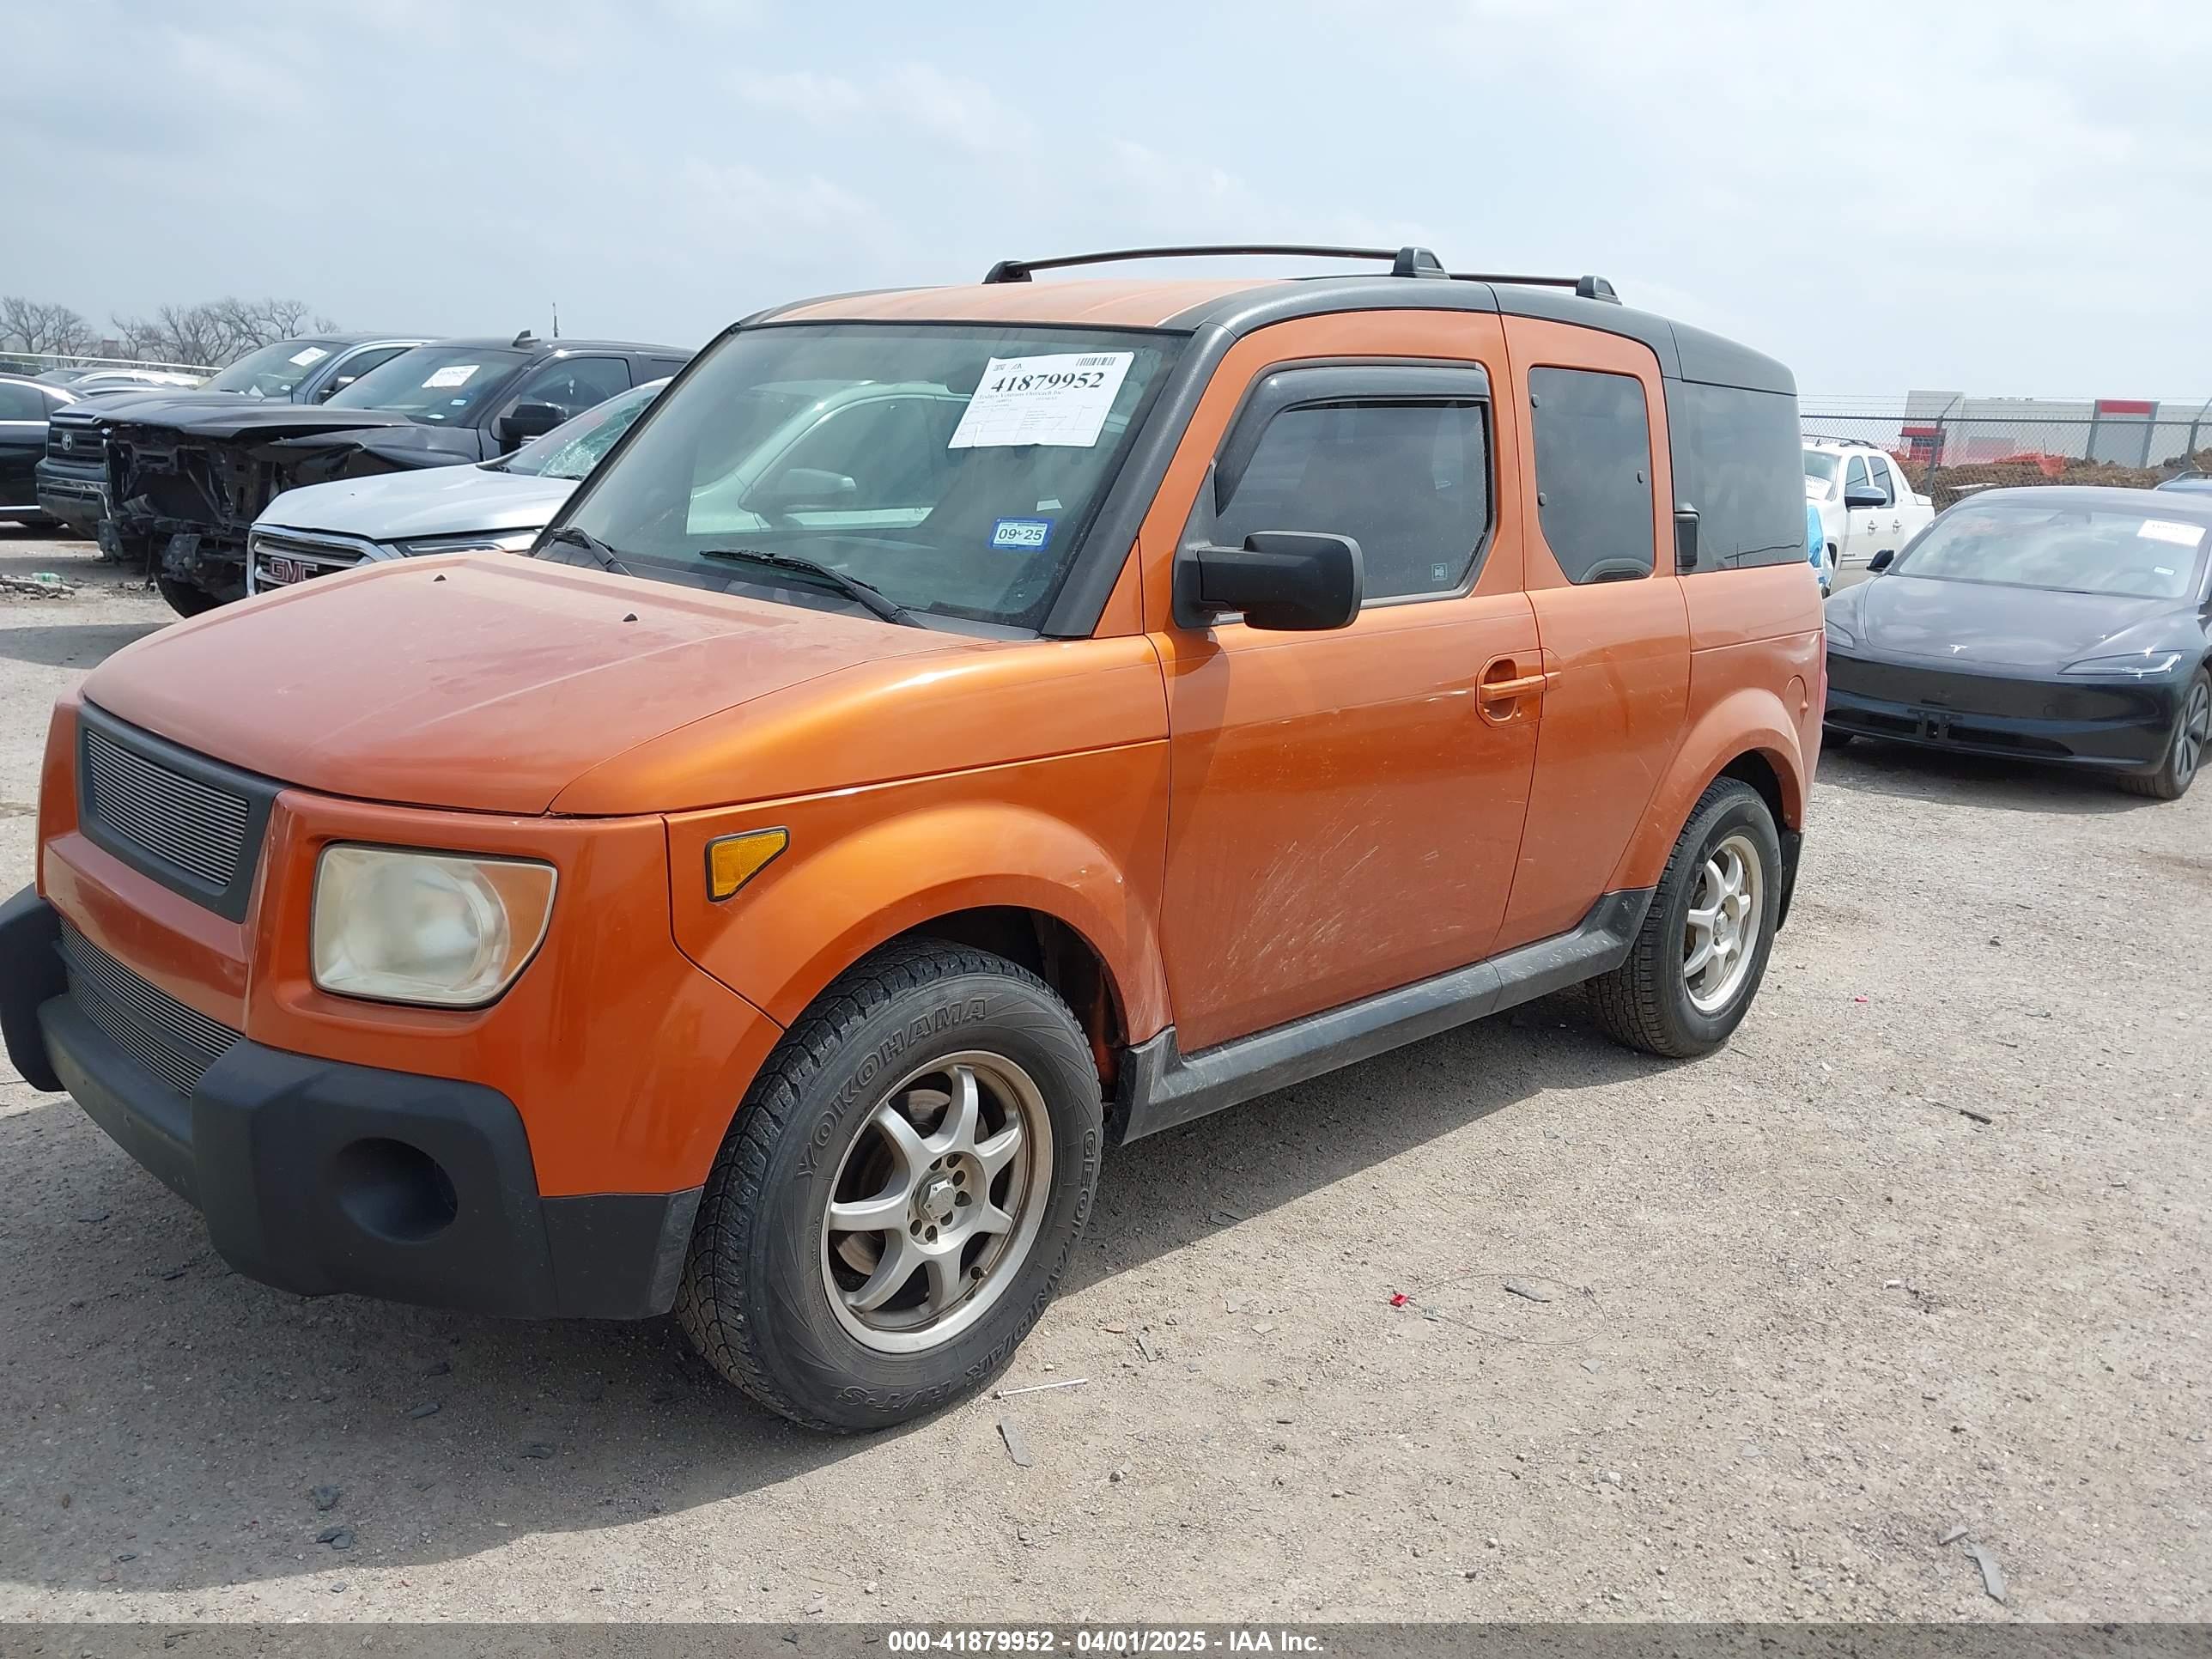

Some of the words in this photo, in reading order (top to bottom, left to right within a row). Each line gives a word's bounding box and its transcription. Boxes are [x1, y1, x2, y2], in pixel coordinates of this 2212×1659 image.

[991, 372, 1105, 392] 41879952
[999, 528, 1018, 540] 09
[1024, 529, 1043, 541] 25
[270, 556, 319, 583] GMC
[795, 996, 988, 1177] YOKOHAMA
